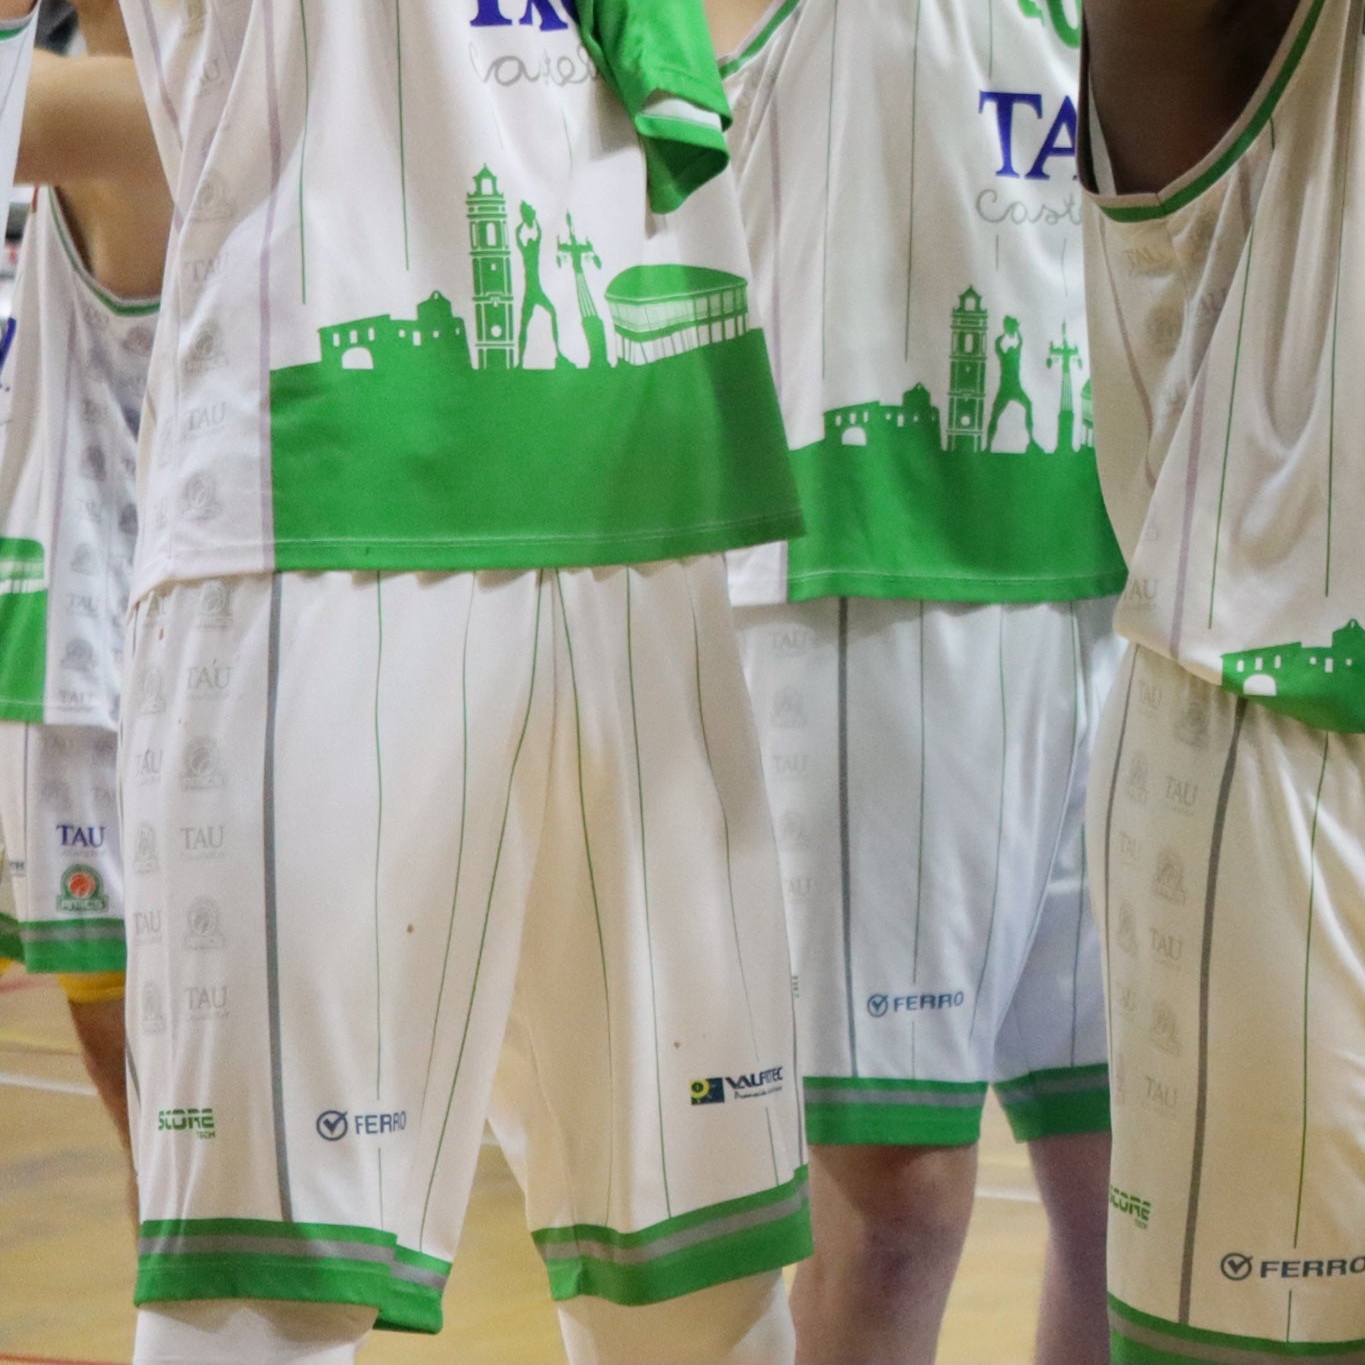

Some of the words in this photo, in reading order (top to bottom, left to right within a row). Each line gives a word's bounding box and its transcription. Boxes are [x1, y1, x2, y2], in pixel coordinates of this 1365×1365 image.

[979, 91, 1080, 181] TA
[187, 402, 226, 431] TAU
[187, 666, 232, 690] TAU
[1166, 775, 1199, 807] TAU
[57, 824, 106, 848] TAU
[181, 825, 225, 850] TAU
[134, 909, 162, 934] TAU
[1151, 927, 1183, 961] TAU
[185, 985, 229, 1011] TAU
[893, 990, 965, 1013] FERRO
[1145, 1075, 1179, 1108] TAU
[354, 1110, 408, 1135] FERRO
